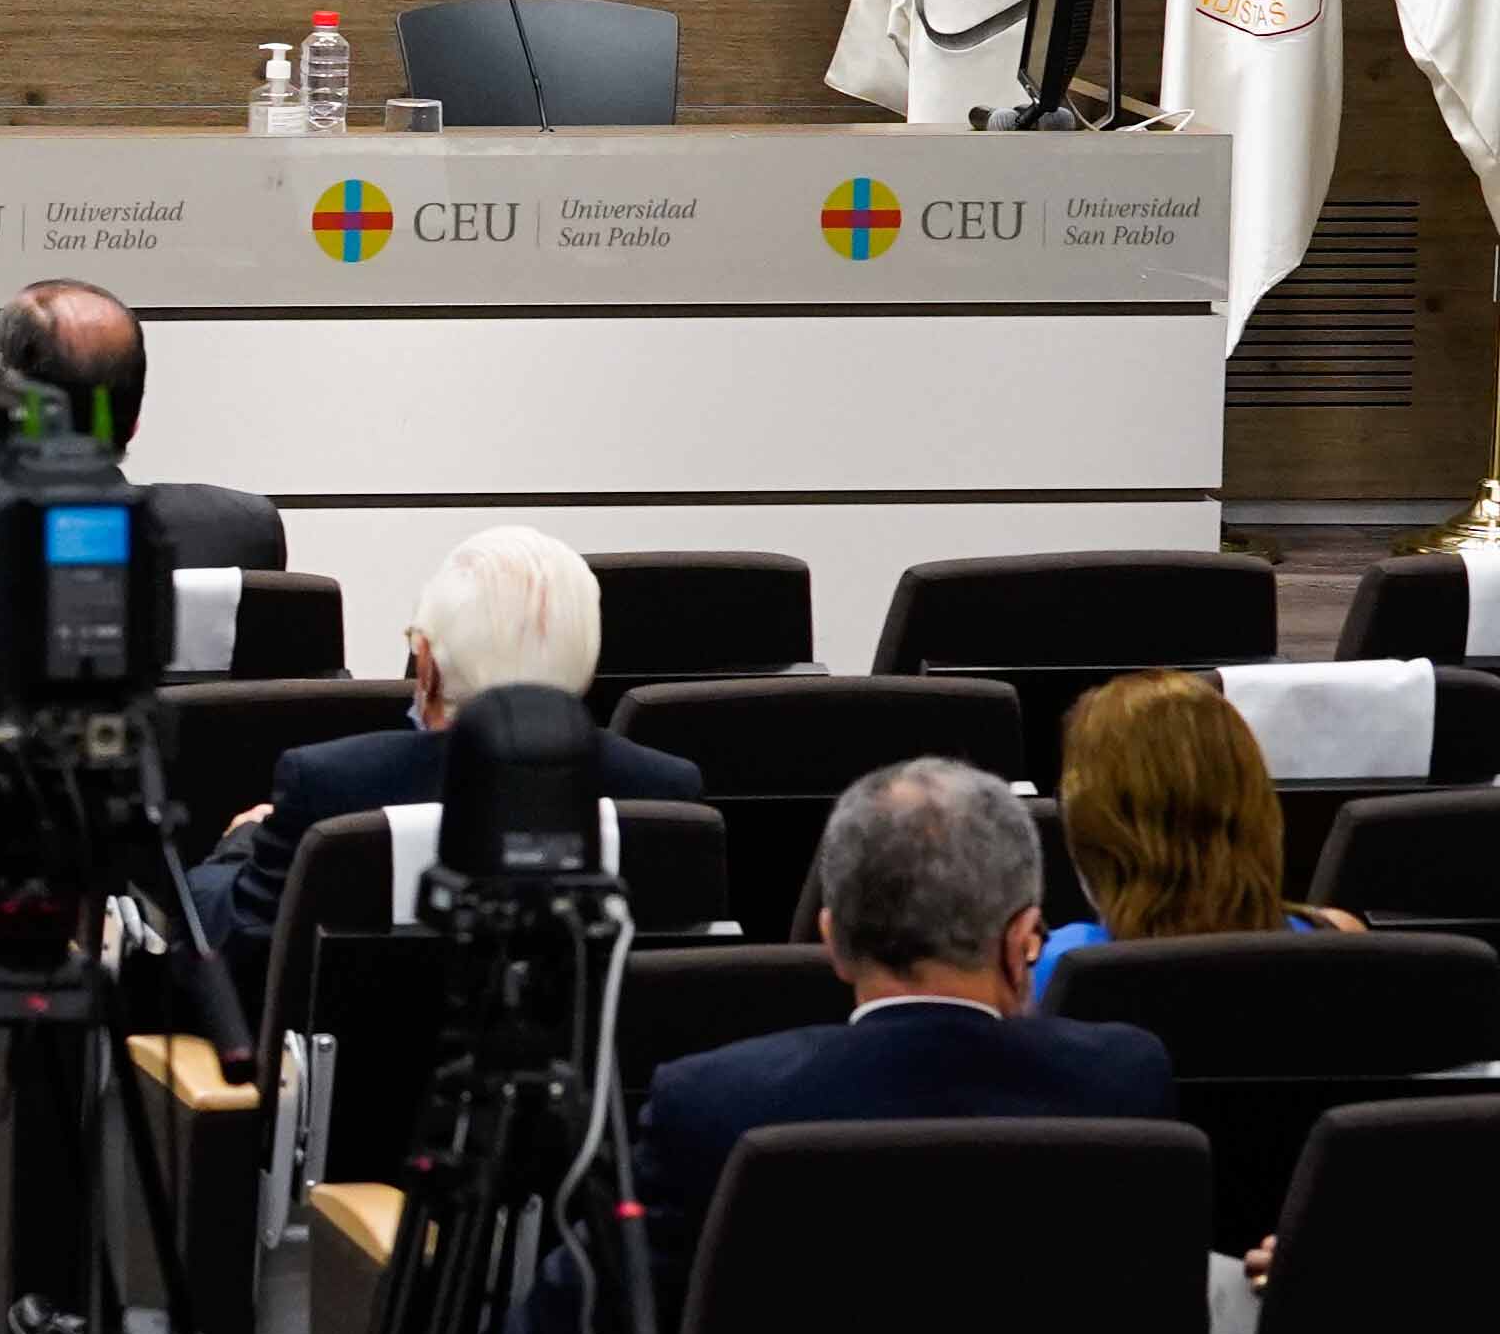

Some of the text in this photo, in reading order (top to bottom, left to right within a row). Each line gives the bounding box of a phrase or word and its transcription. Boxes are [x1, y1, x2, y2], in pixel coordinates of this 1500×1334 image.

[46, 201, 185, 222] Universidad
[561, 199, 697, 219] Universidad
[1067, 197, 1200, 218] Universidad
[413, 203, 520, 242] CEU
[921, 201, 1027, 239] CEU
[44, 229, 157, 250] San Pablo
[559, 227, 670, 247] San Pablo
[1064, 225, 1175, 245] San Pablo
